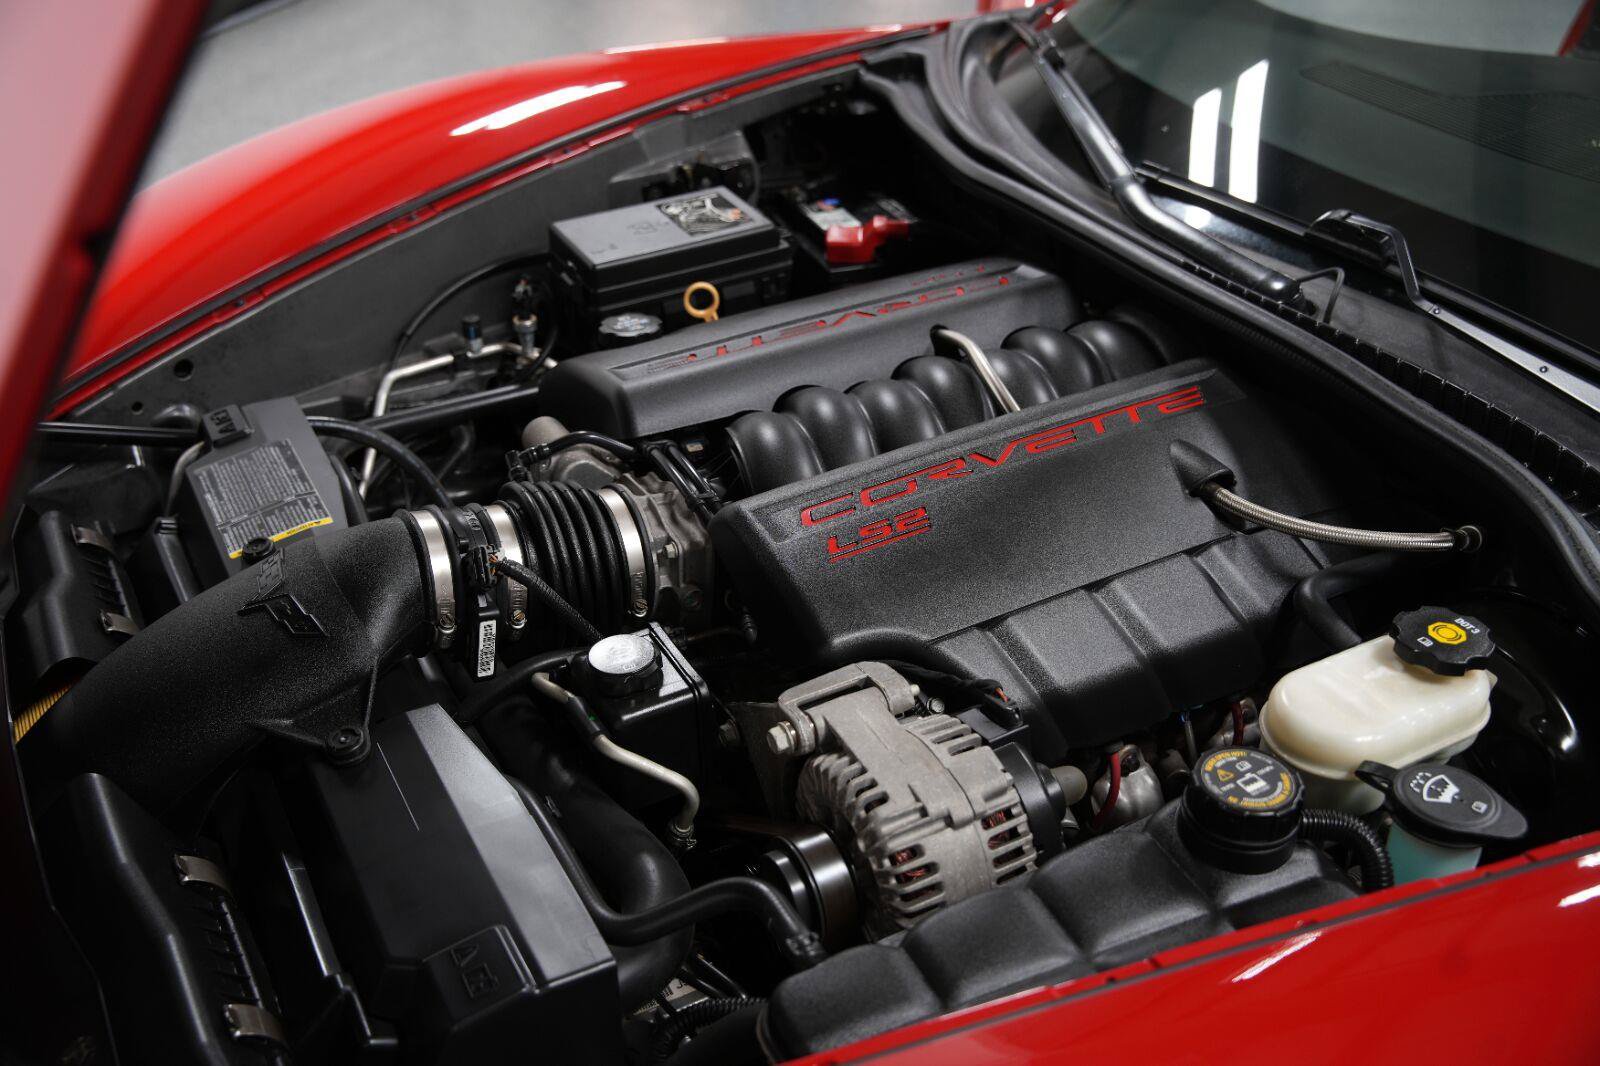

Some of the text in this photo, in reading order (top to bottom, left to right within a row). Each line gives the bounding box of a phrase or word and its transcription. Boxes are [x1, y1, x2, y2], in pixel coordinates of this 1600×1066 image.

[801, 386, 1204, 527] CORVETTE
[827, 506, 931, 557] LS2
[1454, 617, 1475, 629] DOT
